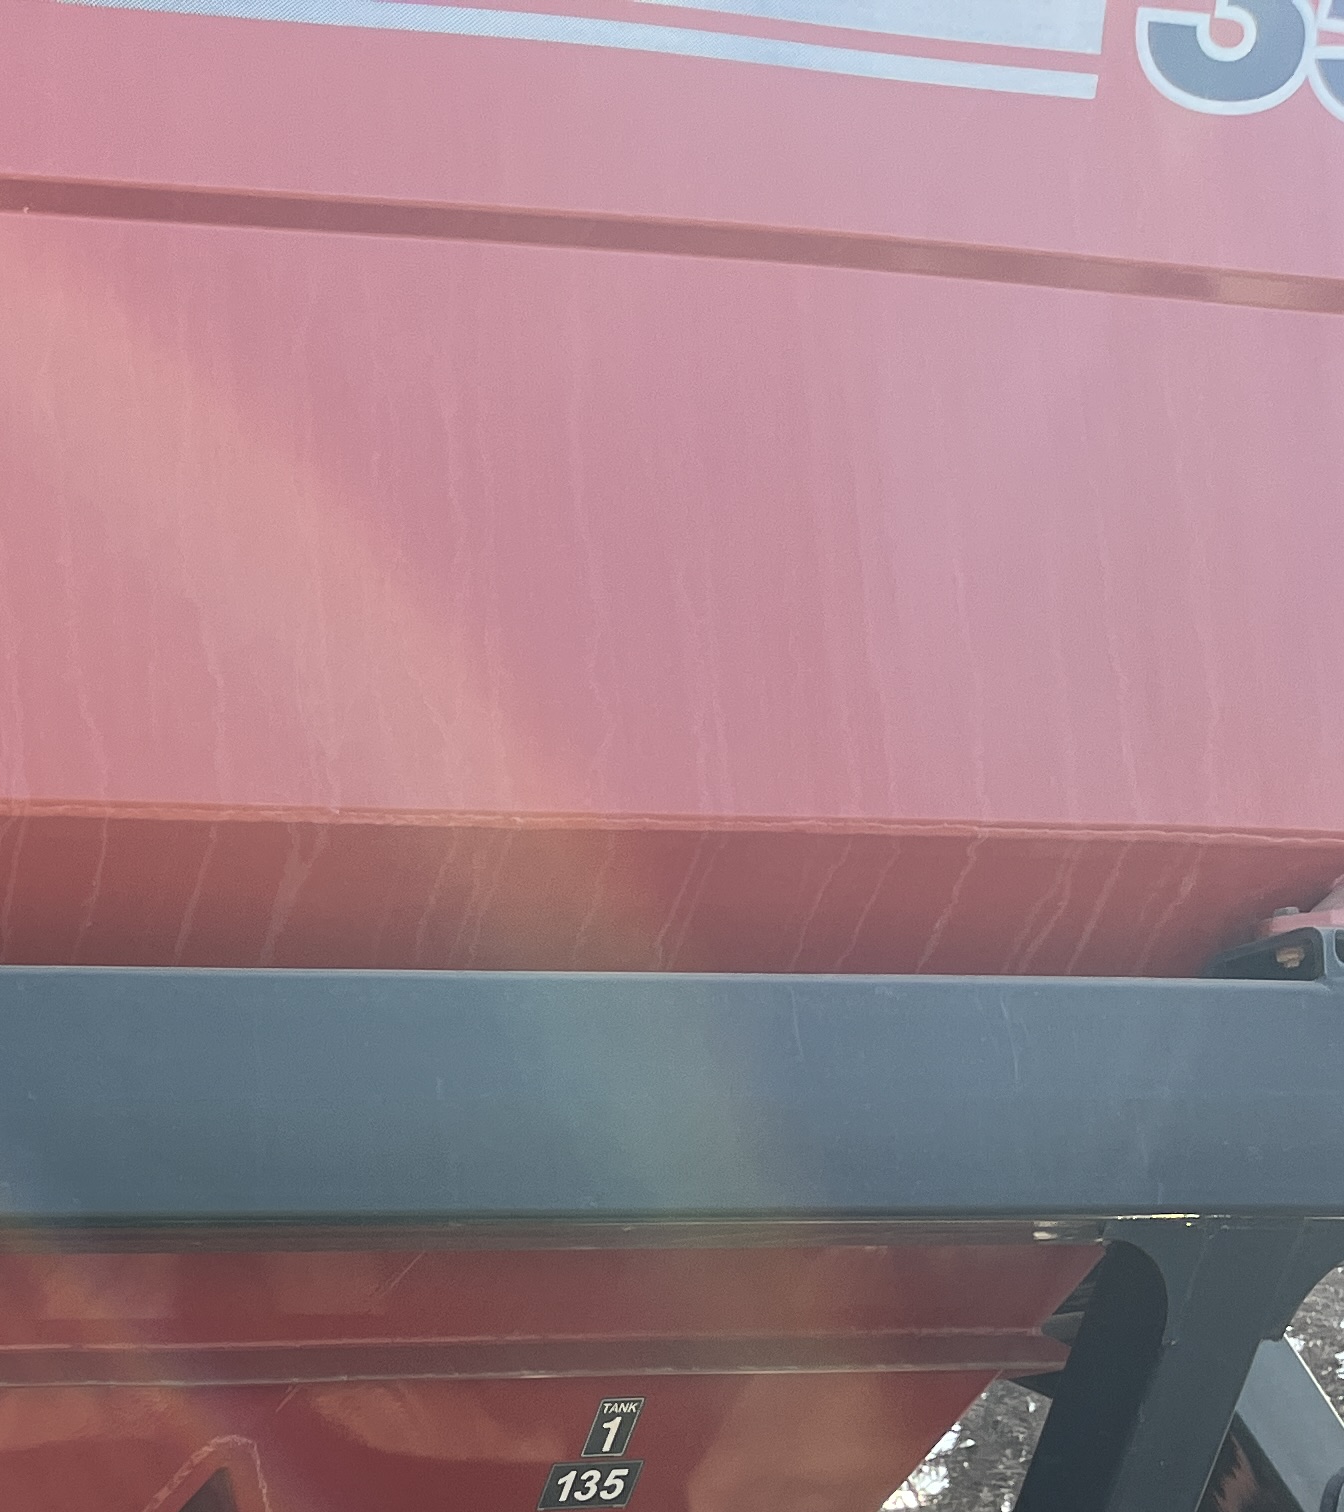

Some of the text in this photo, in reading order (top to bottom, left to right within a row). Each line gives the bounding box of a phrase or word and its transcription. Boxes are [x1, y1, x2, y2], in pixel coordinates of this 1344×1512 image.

[603, 1402, 638, 1414] TANK
[602, 1416, 622, 1452] 1
[557, 1468, 629, 1502] 135
